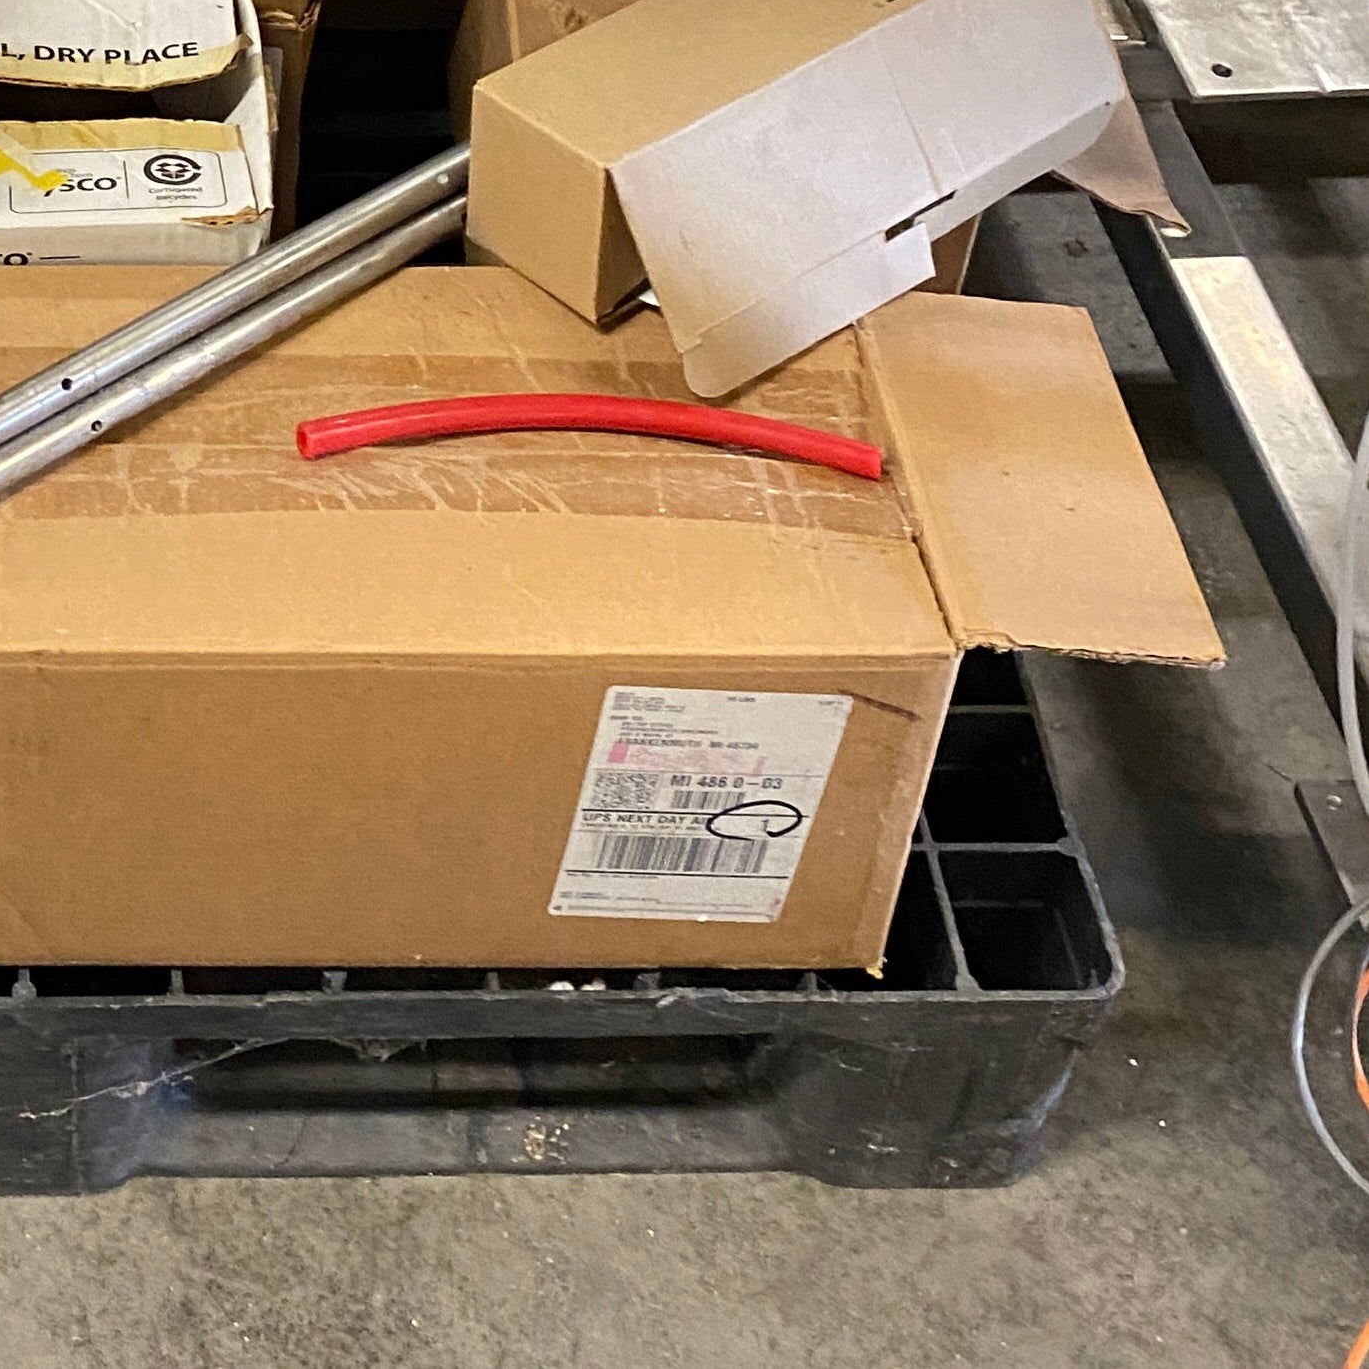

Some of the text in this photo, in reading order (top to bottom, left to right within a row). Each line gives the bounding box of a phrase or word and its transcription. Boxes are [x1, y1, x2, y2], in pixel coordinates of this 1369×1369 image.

[33, 45, 96, 64] DRY
[104, 42, 199, 66] PLACE
[582, 812, 611, 823] UPS
[615, 814, 653, 825] NEXT
[657, 815, 685, 825] DAY
